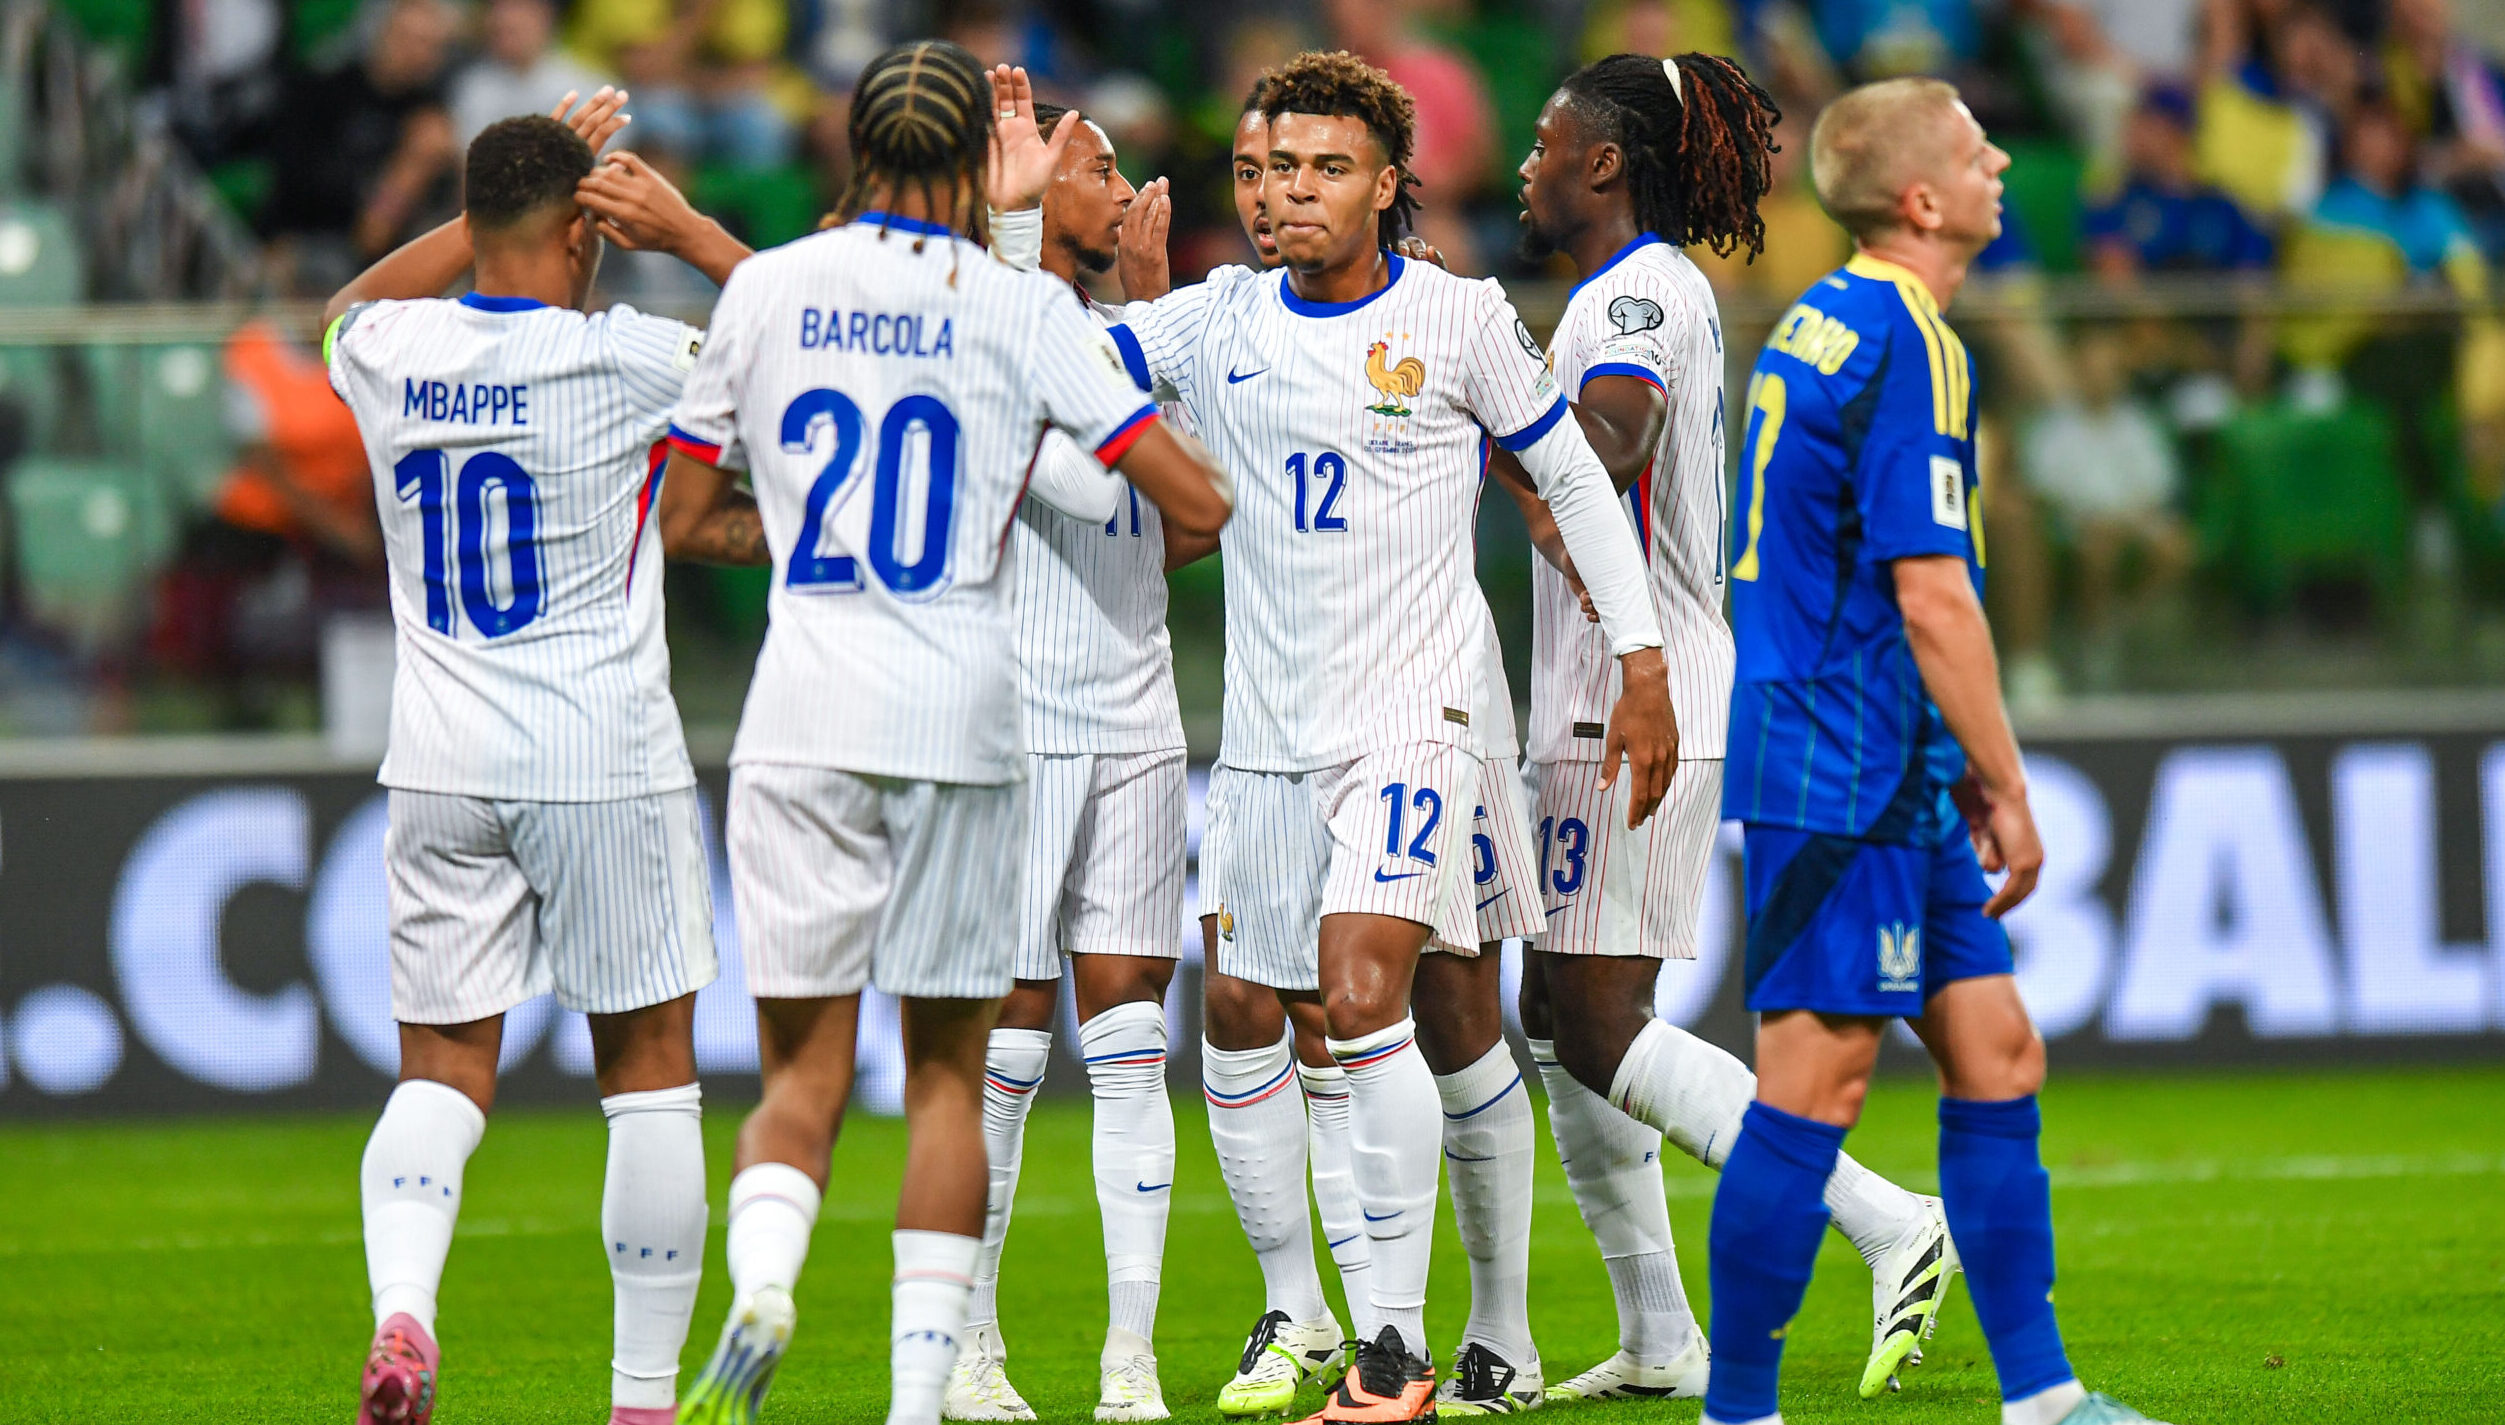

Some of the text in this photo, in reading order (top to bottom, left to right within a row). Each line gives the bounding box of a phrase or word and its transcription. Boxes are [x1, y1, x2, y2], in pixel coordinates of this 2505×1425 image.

[800, 309, 954, 359] BARCOLA
[404, 377, 528, 425] MBAPPE
[779, 388, 967, 604] 20
[1285, 452, 1348, 534] 12
[394, 447, 549, 640] 10
[1381, 783, 1444, 869] 12
[1539, 815, 1591, 897] 13
